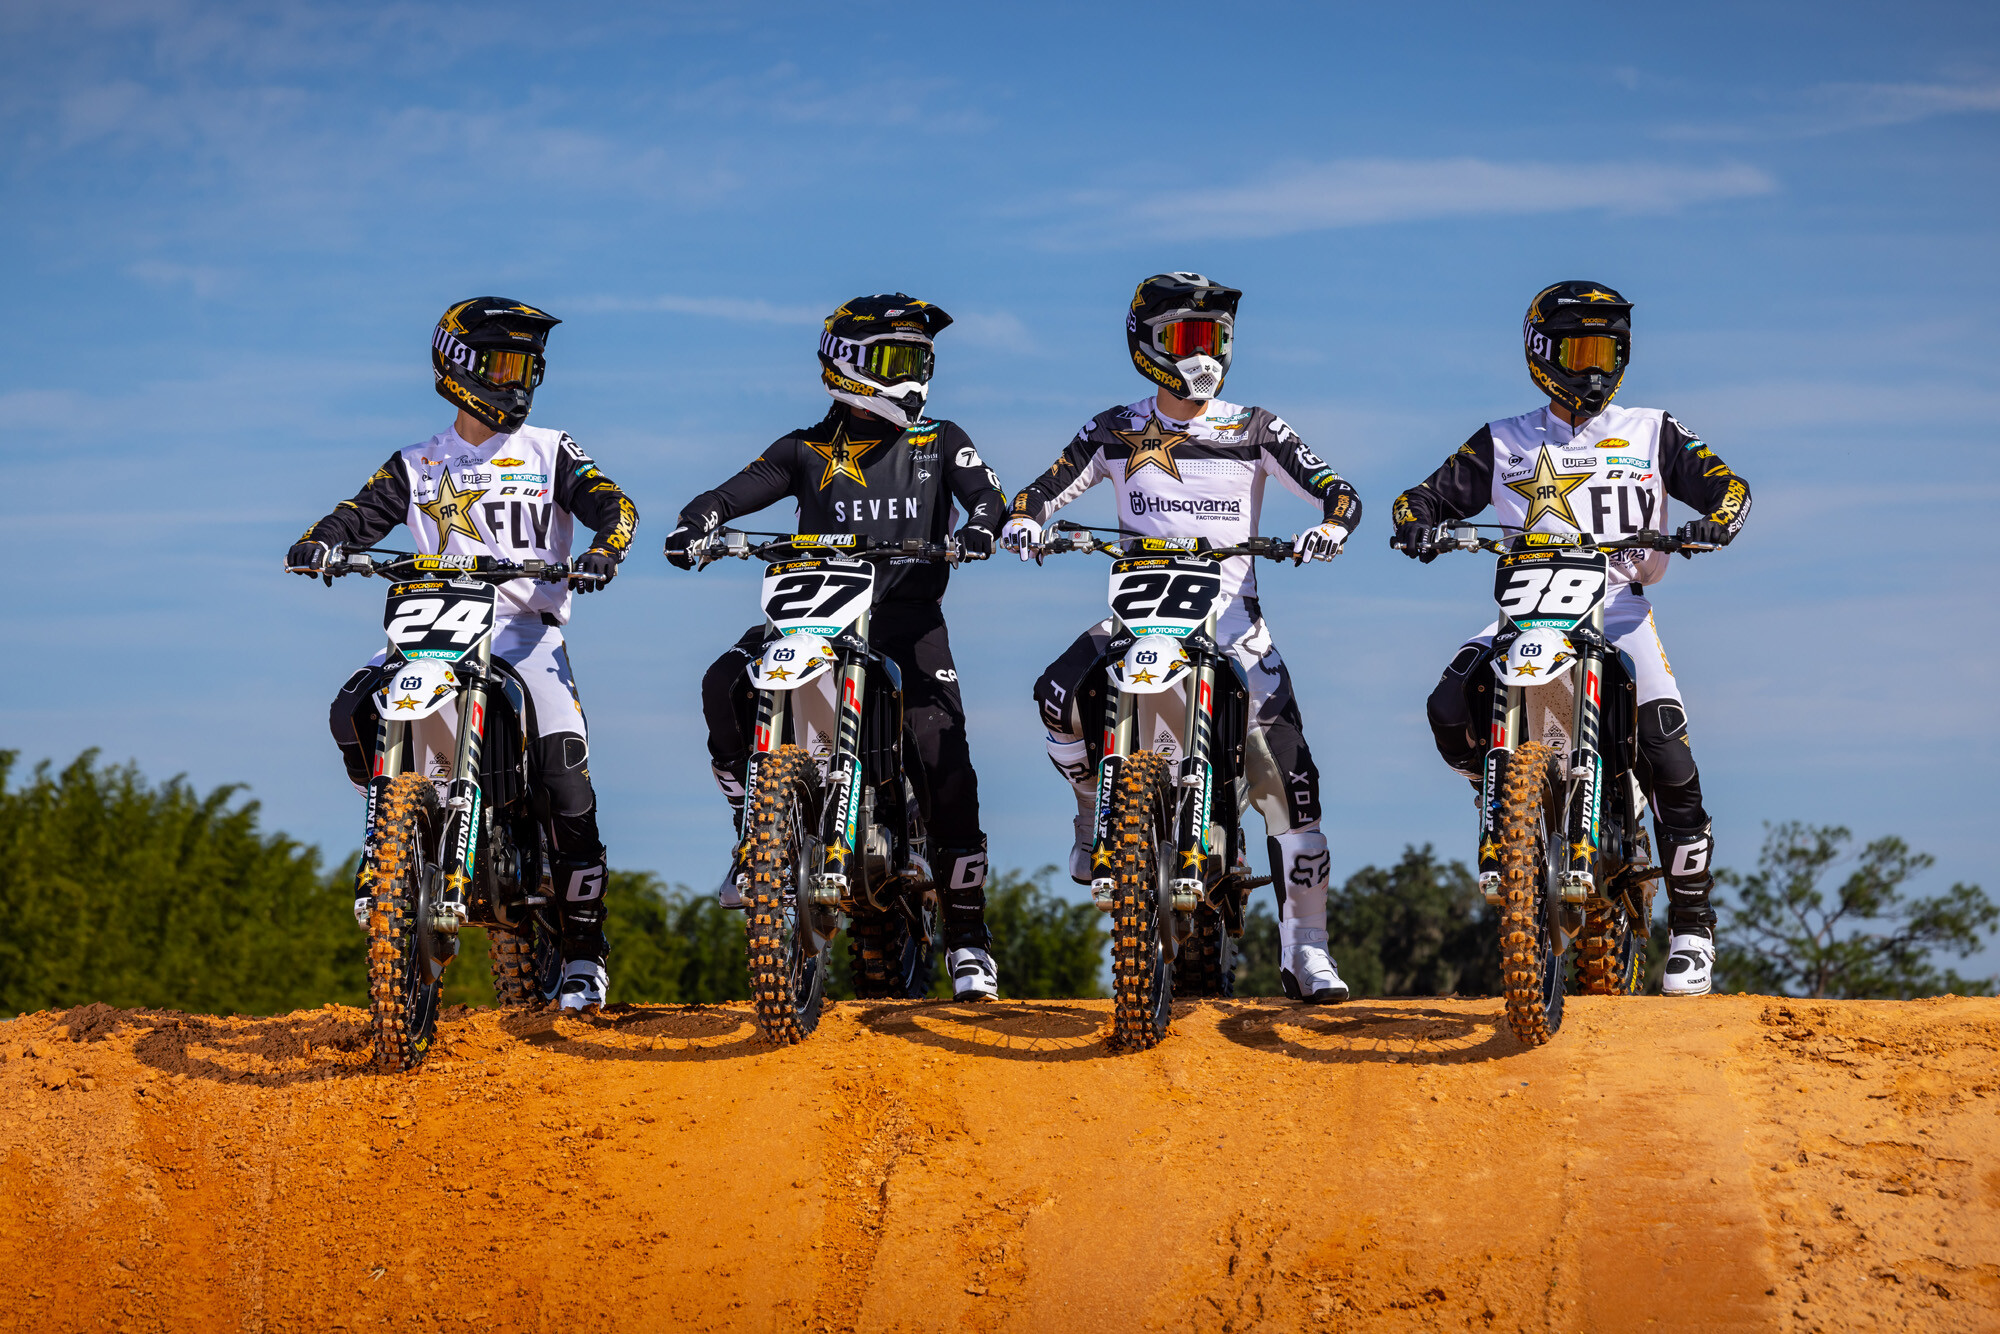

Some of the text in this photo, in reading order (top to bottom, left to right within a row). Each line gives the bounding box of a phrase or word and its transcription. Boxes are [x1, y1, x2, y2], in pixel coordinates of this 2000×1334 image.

[824, 367, 875, 397] ROCKSTAR
[1133, 349, 1182, 391] ROCKSTAR
[1529, 361, 1583, 410] ROCKSR
[443, 374, 507, 425] ROCKSR
[1506, 469, 1532, 479] SCOTT
[1563, 457, 1597, 468] WPS
[1618, 457, 1649, 468] MOTOREX
[461, 474, 491, 484] WPS
[513, 474, 547, 483] MOTOREX
[523, 488, 548, 497] WP
[834, 498, 917, 522] SEVEN
[1149, 497, 1240, 514] Husqvarna
[1588, 486, 1656, 535] FLY
[482, 501, 552, 550] FLY
[793, 535, 854, 546] PROTAPER
[786, 561, 822, 569] ROCKSTAR
[1133, 559, 1169, 567] ROCKSTAR
[1518, 552, 1554, 560] ROCKSTAR
[765, 574, 872, 621] 27
[1111, 573, 1221, 620] 28
[1500, 568, 1605, 616] 38
[386, 598, 493, 645] 24
[797, 626, 835, 635] MOTOREX
[1147, 627, 1186, 635] MOTOREX
[1531, 620, 1570, 628] MOTOREX
[419, 650, 457, 659] MOTOREX
[1044, 679, 1066, 734] FOX
[849, 769, 862, 827] MOTOREX
[1289, 770, 1313, 823] FOX
[364, 784, 378, 858] DUNP
[468, 793, 482, 853] MOTOREX
